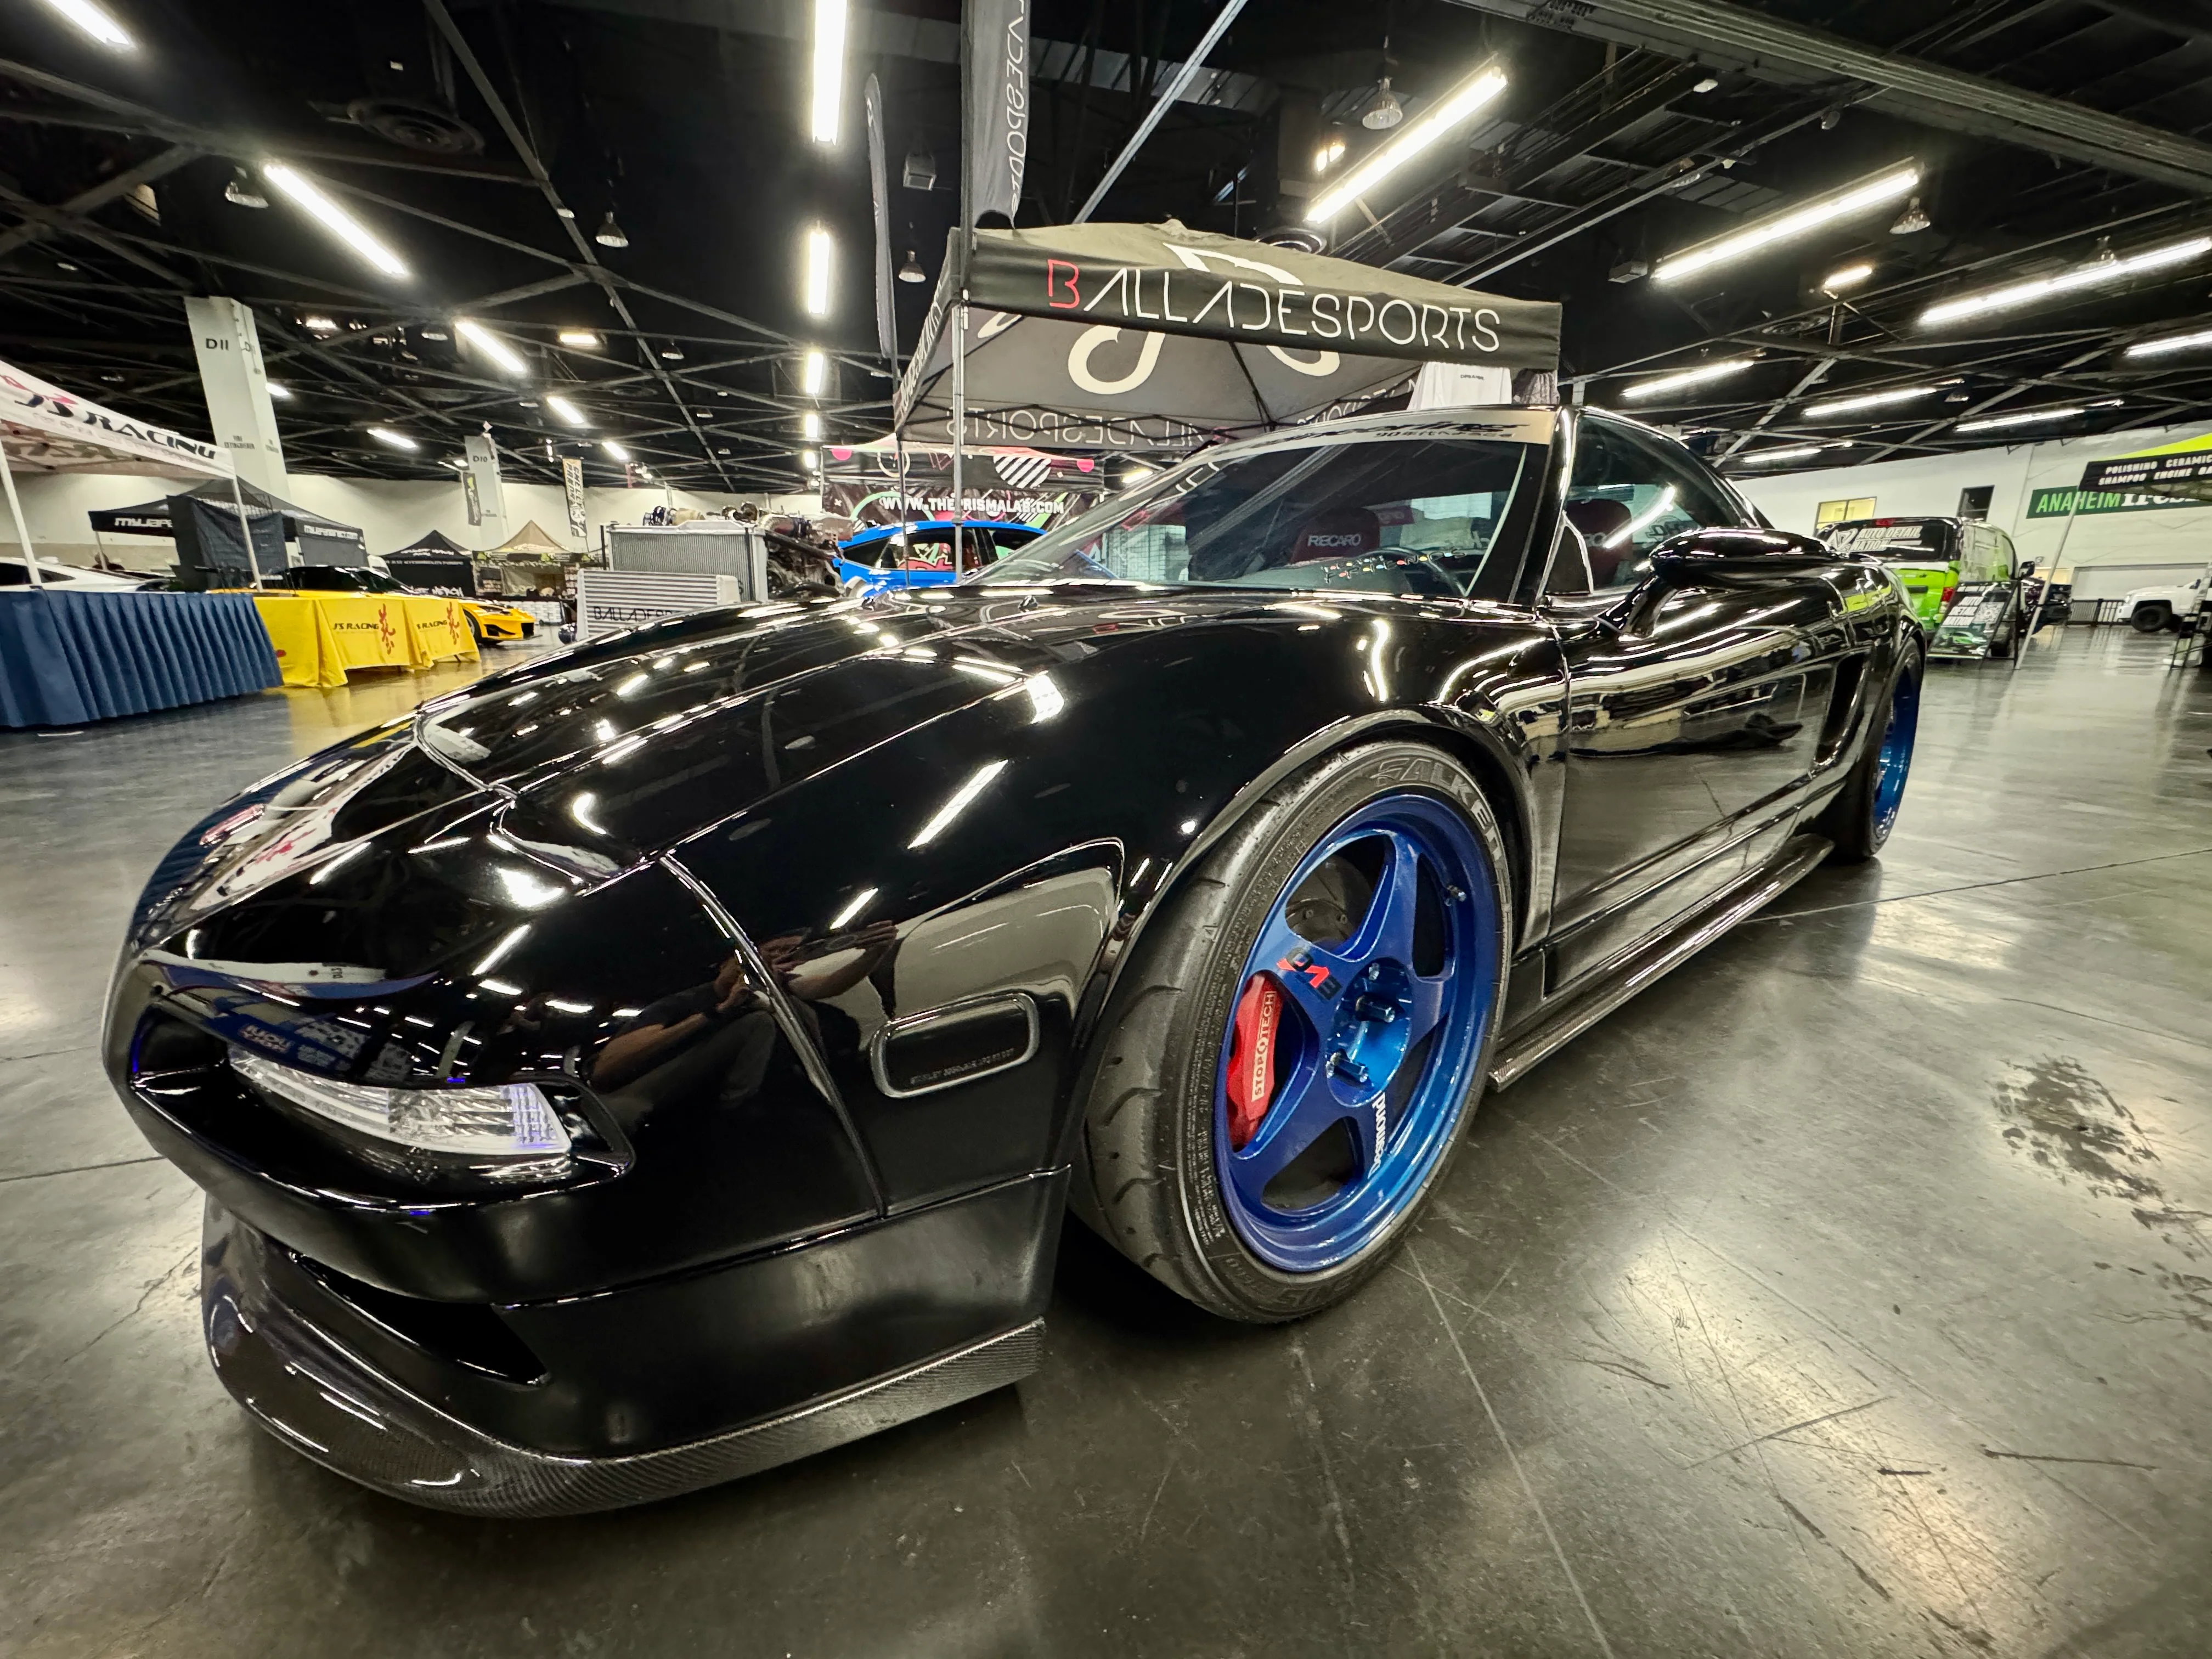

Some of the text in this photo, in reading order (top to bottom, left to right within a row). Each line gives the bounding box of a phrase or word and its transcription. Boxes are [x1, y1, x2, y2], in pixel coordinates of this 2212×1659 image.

[1047, 258, 1500, 352] BALLADESPORTS
[2105, 461, 2158, 475] POLISHING
[880, 496, 1065, 515] WWW.THERISMALAB.COM
[2036, 490, 2121, 514] ANAHEIM
[1307, 534, 1361, 547] RECARO
[1857, 526, 1922, 545] AUTO DETAIL
[1368, 1092, 1386, 1179] Desmond
